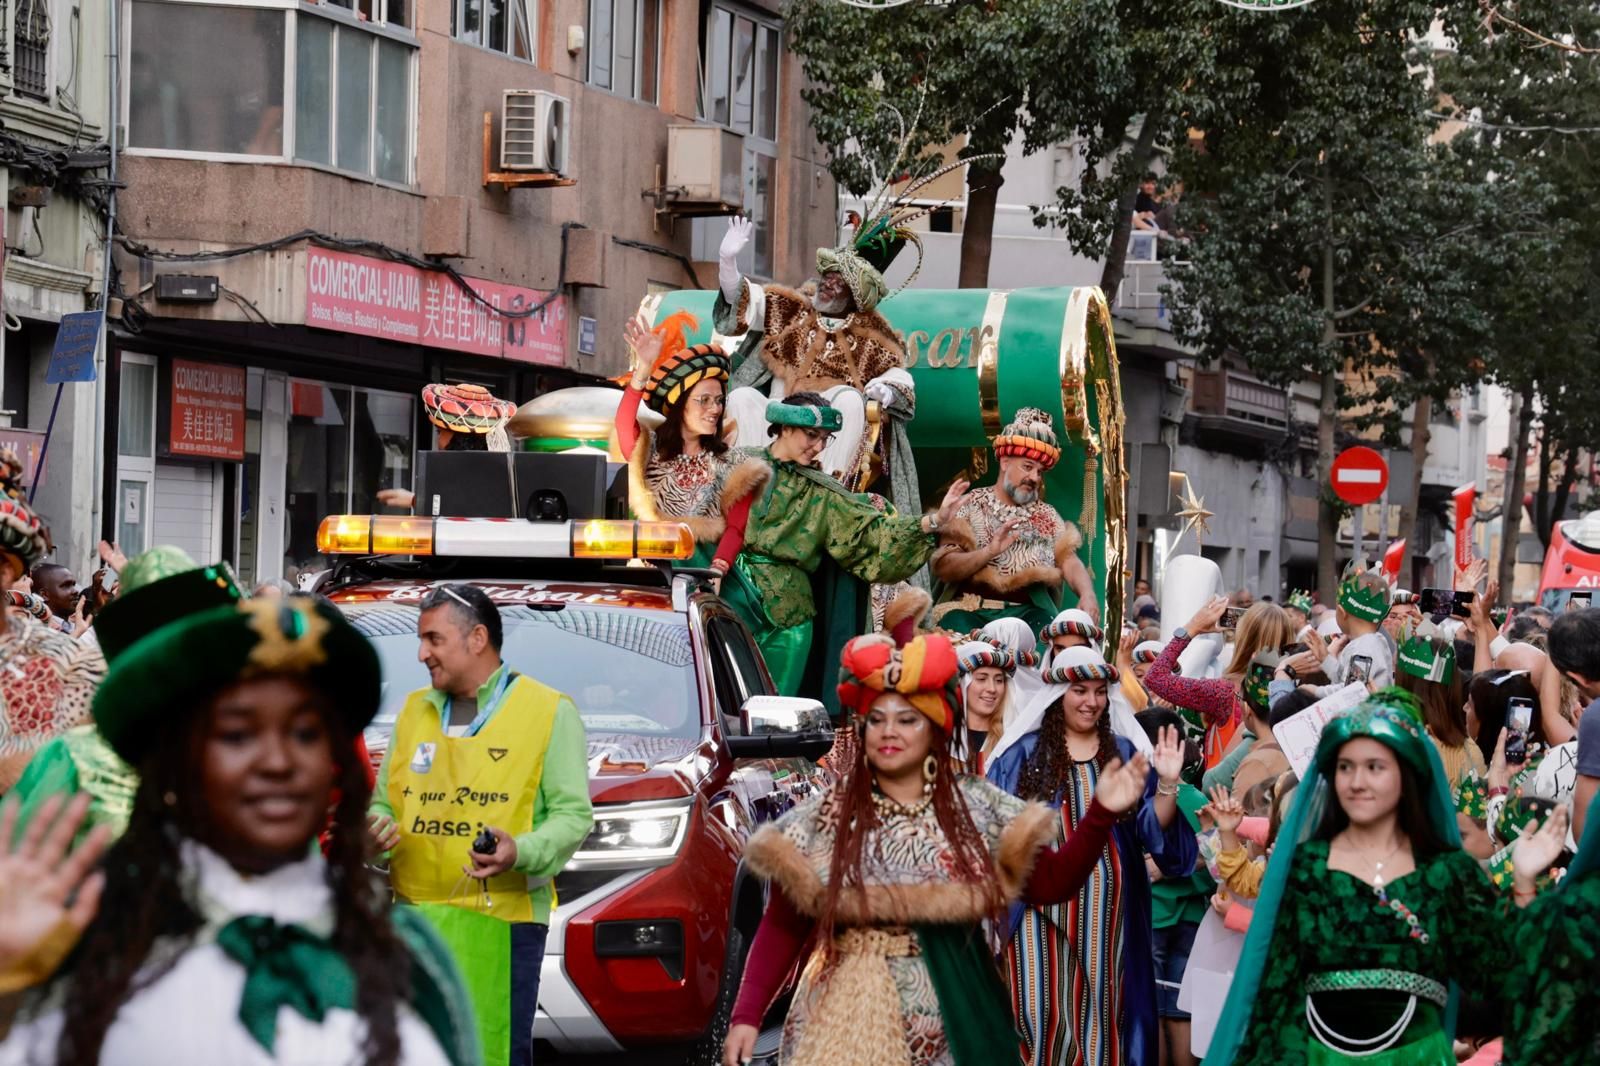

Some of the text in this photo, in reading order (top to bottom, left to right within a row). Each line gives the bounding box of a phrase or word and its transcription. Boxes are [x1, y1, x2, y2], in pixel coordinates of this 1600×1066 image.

[309, 254, 421, 313] COMERCIAL-JIAJIA
[423, 279, 502, 346] 美佳佳饰品
[906, 324, 994, 369] sar
[175, 367, 245, 396] COMERCIAL-JIAJIA
[387, 583, 622, 603] Btasar
[1576, 575, 1600, 588] AI
[420, 790, 446, 806] que
[451, 786, 509, 807] Reyes
